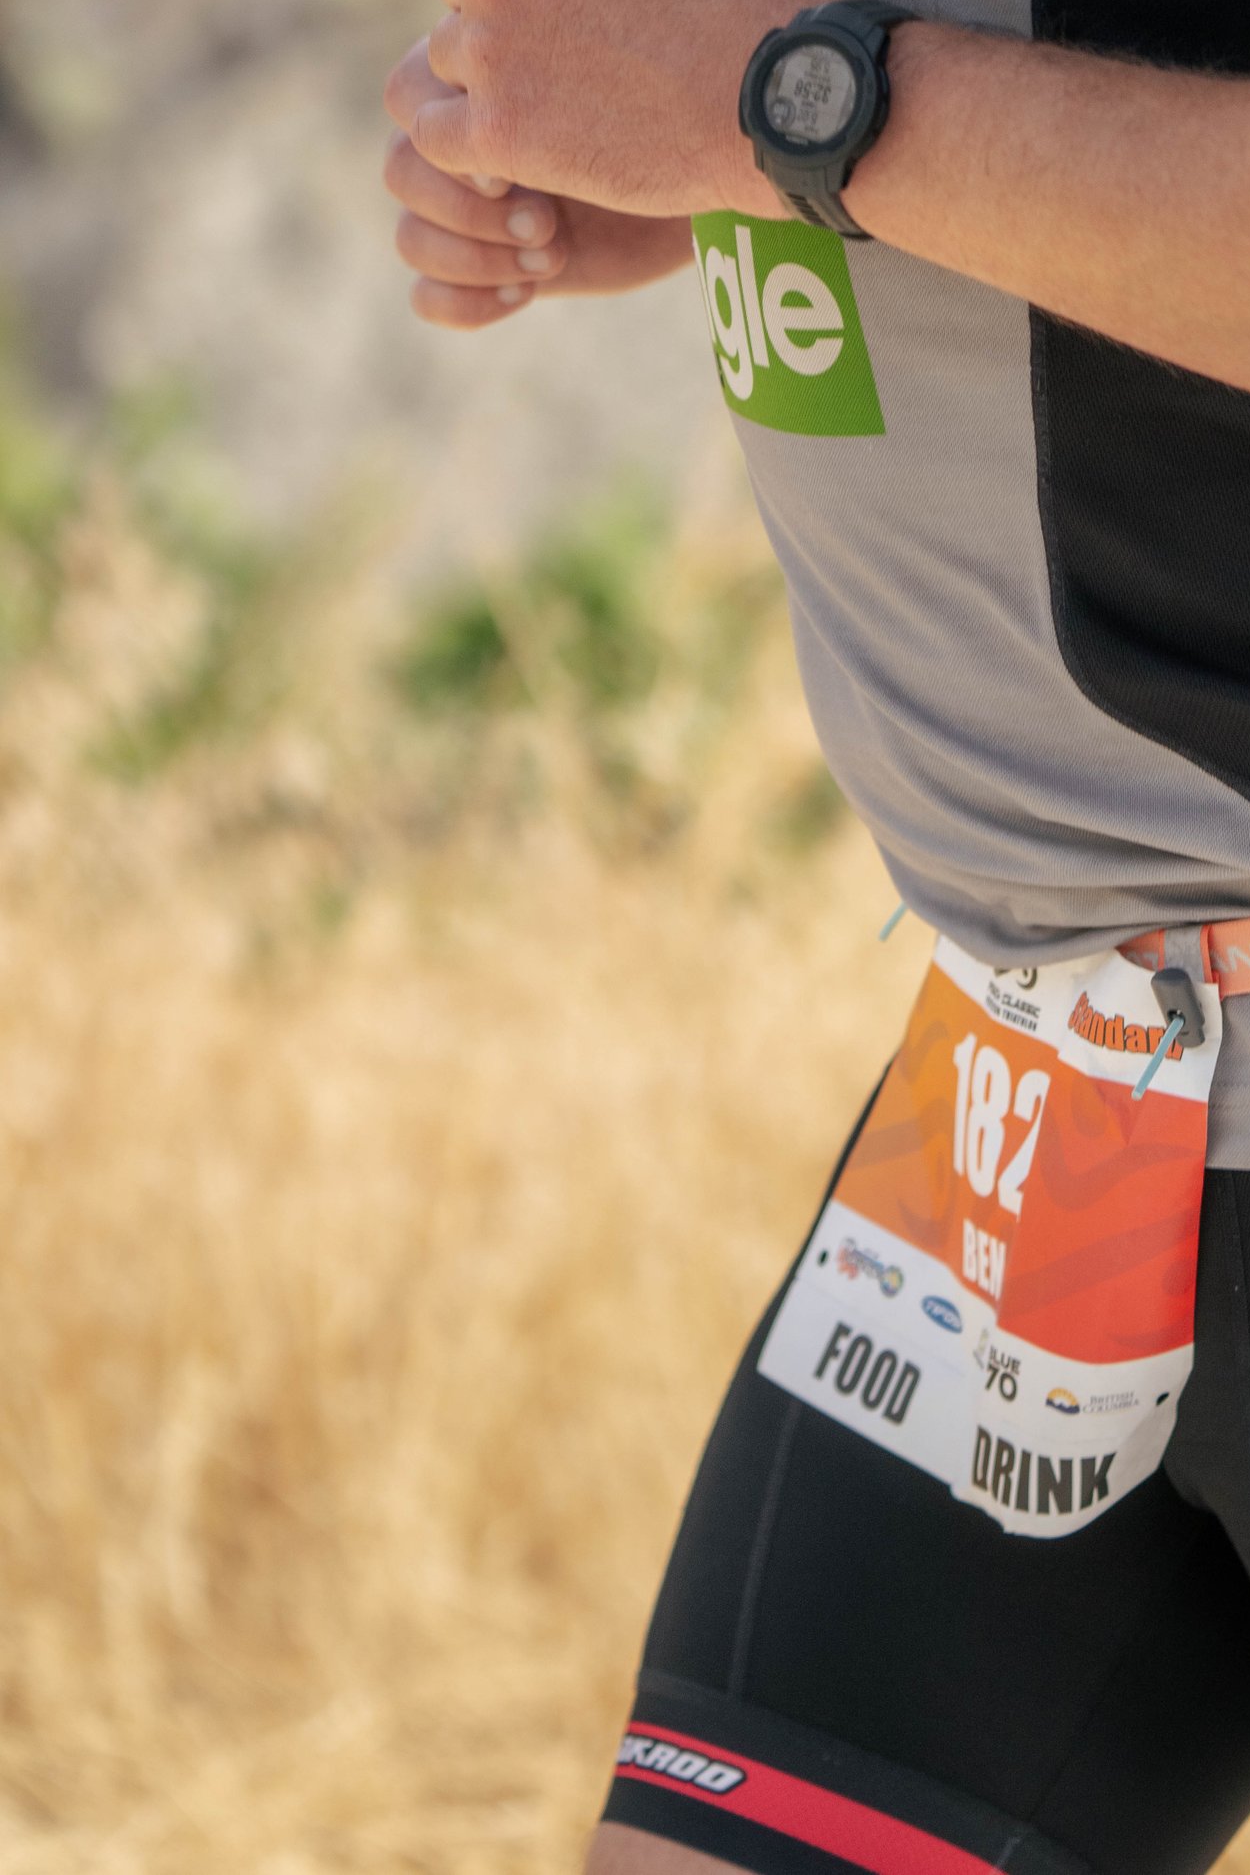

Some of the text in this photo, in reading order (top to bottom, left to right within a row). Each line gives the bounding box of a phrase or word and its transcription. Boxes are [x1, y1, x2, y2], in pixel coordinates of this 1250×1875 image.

[953, 1032, 1051, 1216] 182
[962, 1219, 1006, 1299] BEN
[813, 1321, 922, 1426] FOOD
[971, 1426, 1117, 1516] DRINK
